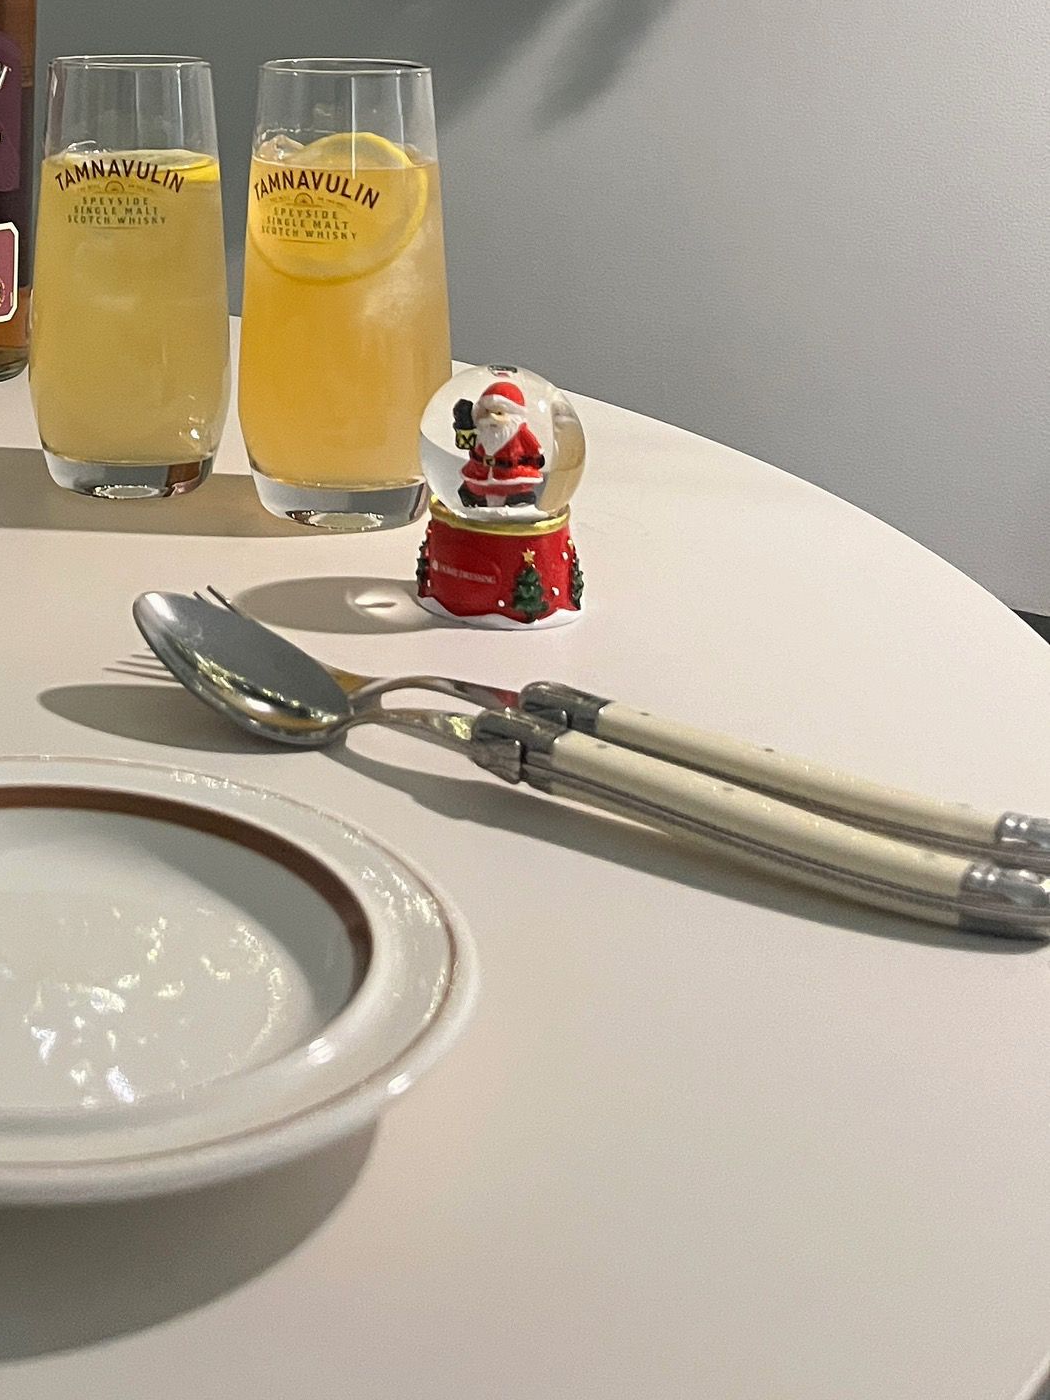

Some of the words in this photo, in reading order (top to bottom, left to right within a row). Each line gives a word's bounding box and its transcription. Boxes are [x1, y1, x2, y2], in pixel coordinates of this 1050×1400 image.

[55, 159, 185, 193] TAMNAVULIN
[254, 169, 380, 209] TAMNAVULIN
[82, 196, 148, 206] SPEYSIDE
[74, 205, 116, 215] SINGLE
[125, 206, 159, 216] MALT
[273, 207, 338, 219] SPEYSIDE
[67, 214, 110, 224] SCOTCH
[117, 216, 166, 225] WHISKY
[267, 216, 305, 228] SINGLE
[313, 220, 349, 230] MALT
[261, 225, 299, 237] SCOTCH
[305, 230, 358, 241] WHISKY
